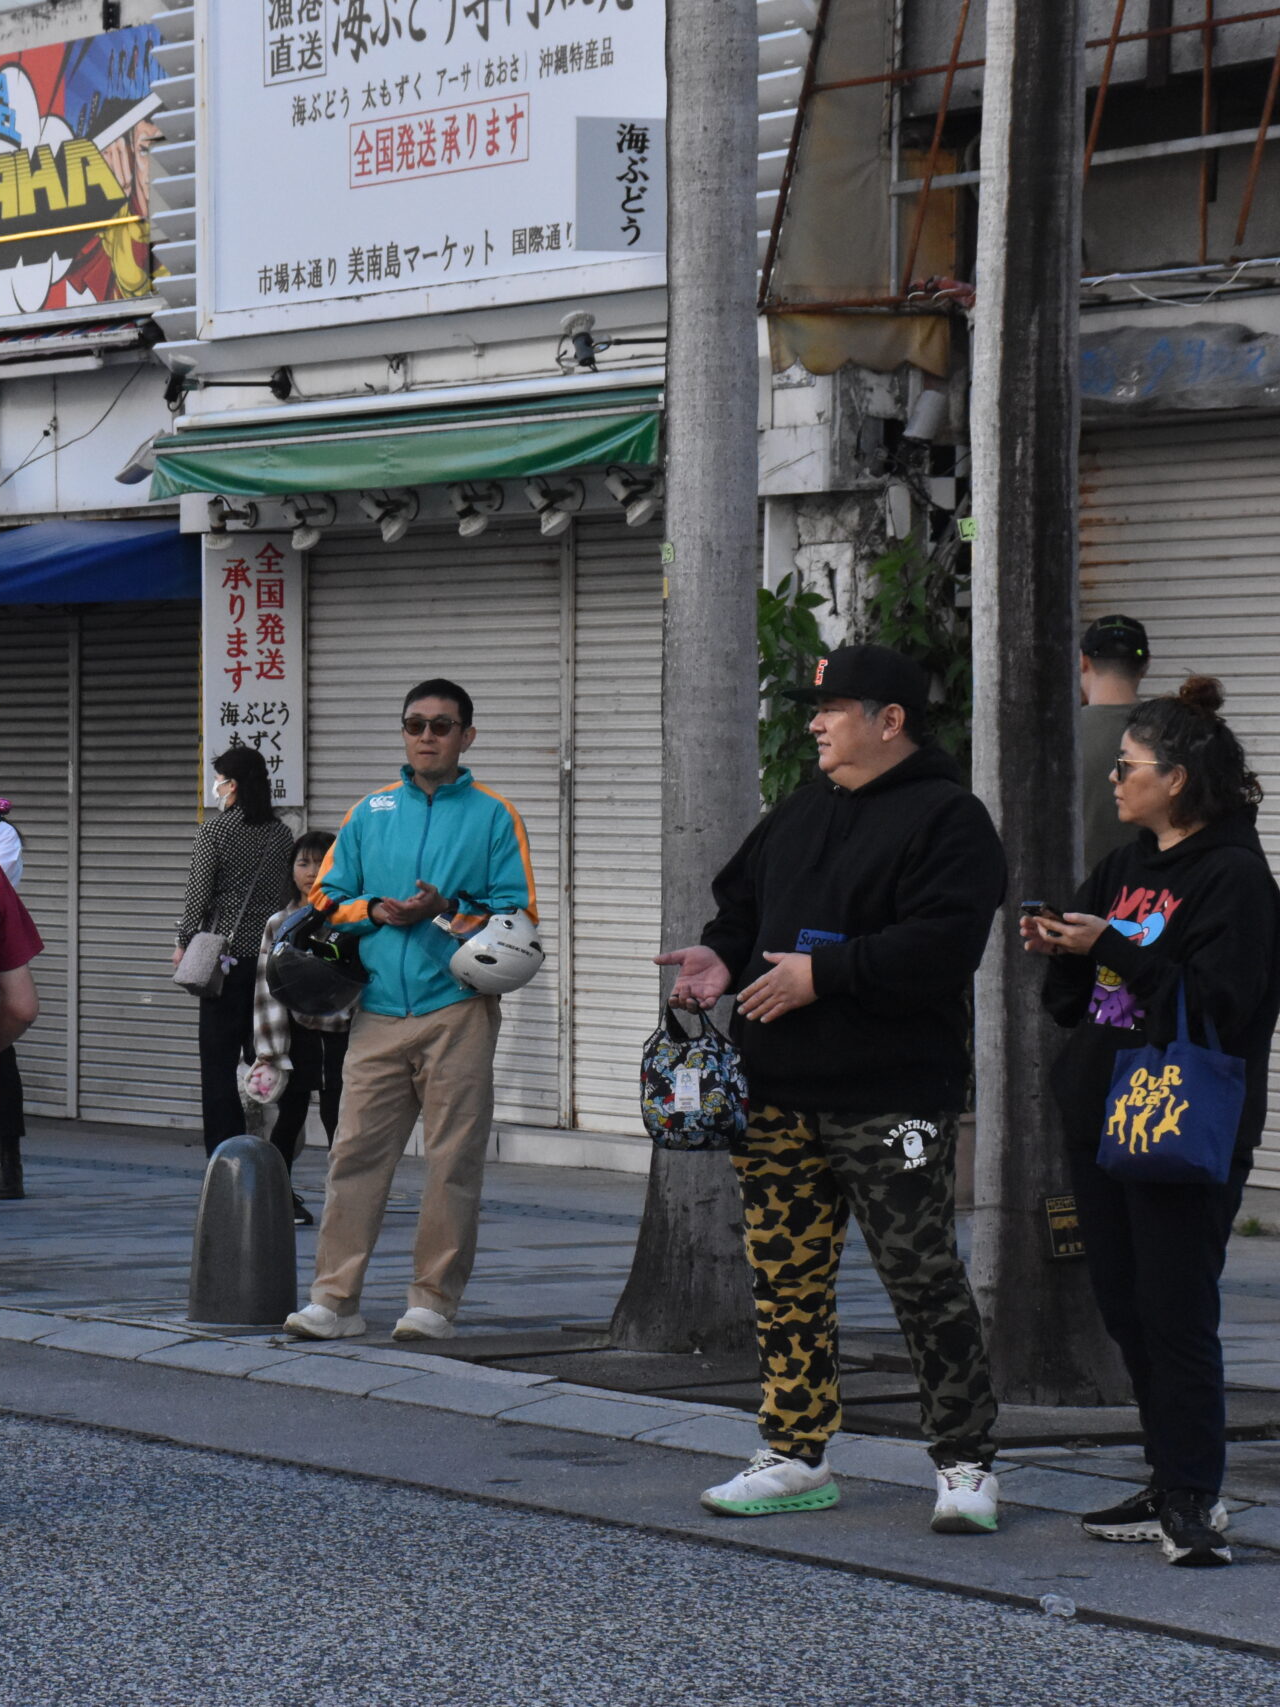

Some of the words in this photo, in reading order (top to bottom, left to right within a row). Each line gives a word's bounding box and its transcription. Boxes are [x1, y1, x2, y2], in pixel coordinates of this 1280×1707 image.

[269, 30, 323, 77] 直送
[292, 87, 350, 127] 海ぶどう
[361, 74, 422, 111] 太もずく
[539, 37, 614, 79] 沖縄特産品
[353, 102, 525, 177] 全国発送承ります
[616, 123, 650, 247] 海ぶどう
[258, 257, 338, 295] 市場本通り
[348, 230, 494, 284] 美南島マーケット
[221, 558, 252, 693] 承ります
[255, 542, 286, 681] 全国発送
[220, 701, 290, 727] 海ぶどう
[889, 1120, 938, 1138] BATHING
[904, 1157, 927, 1169] APE
